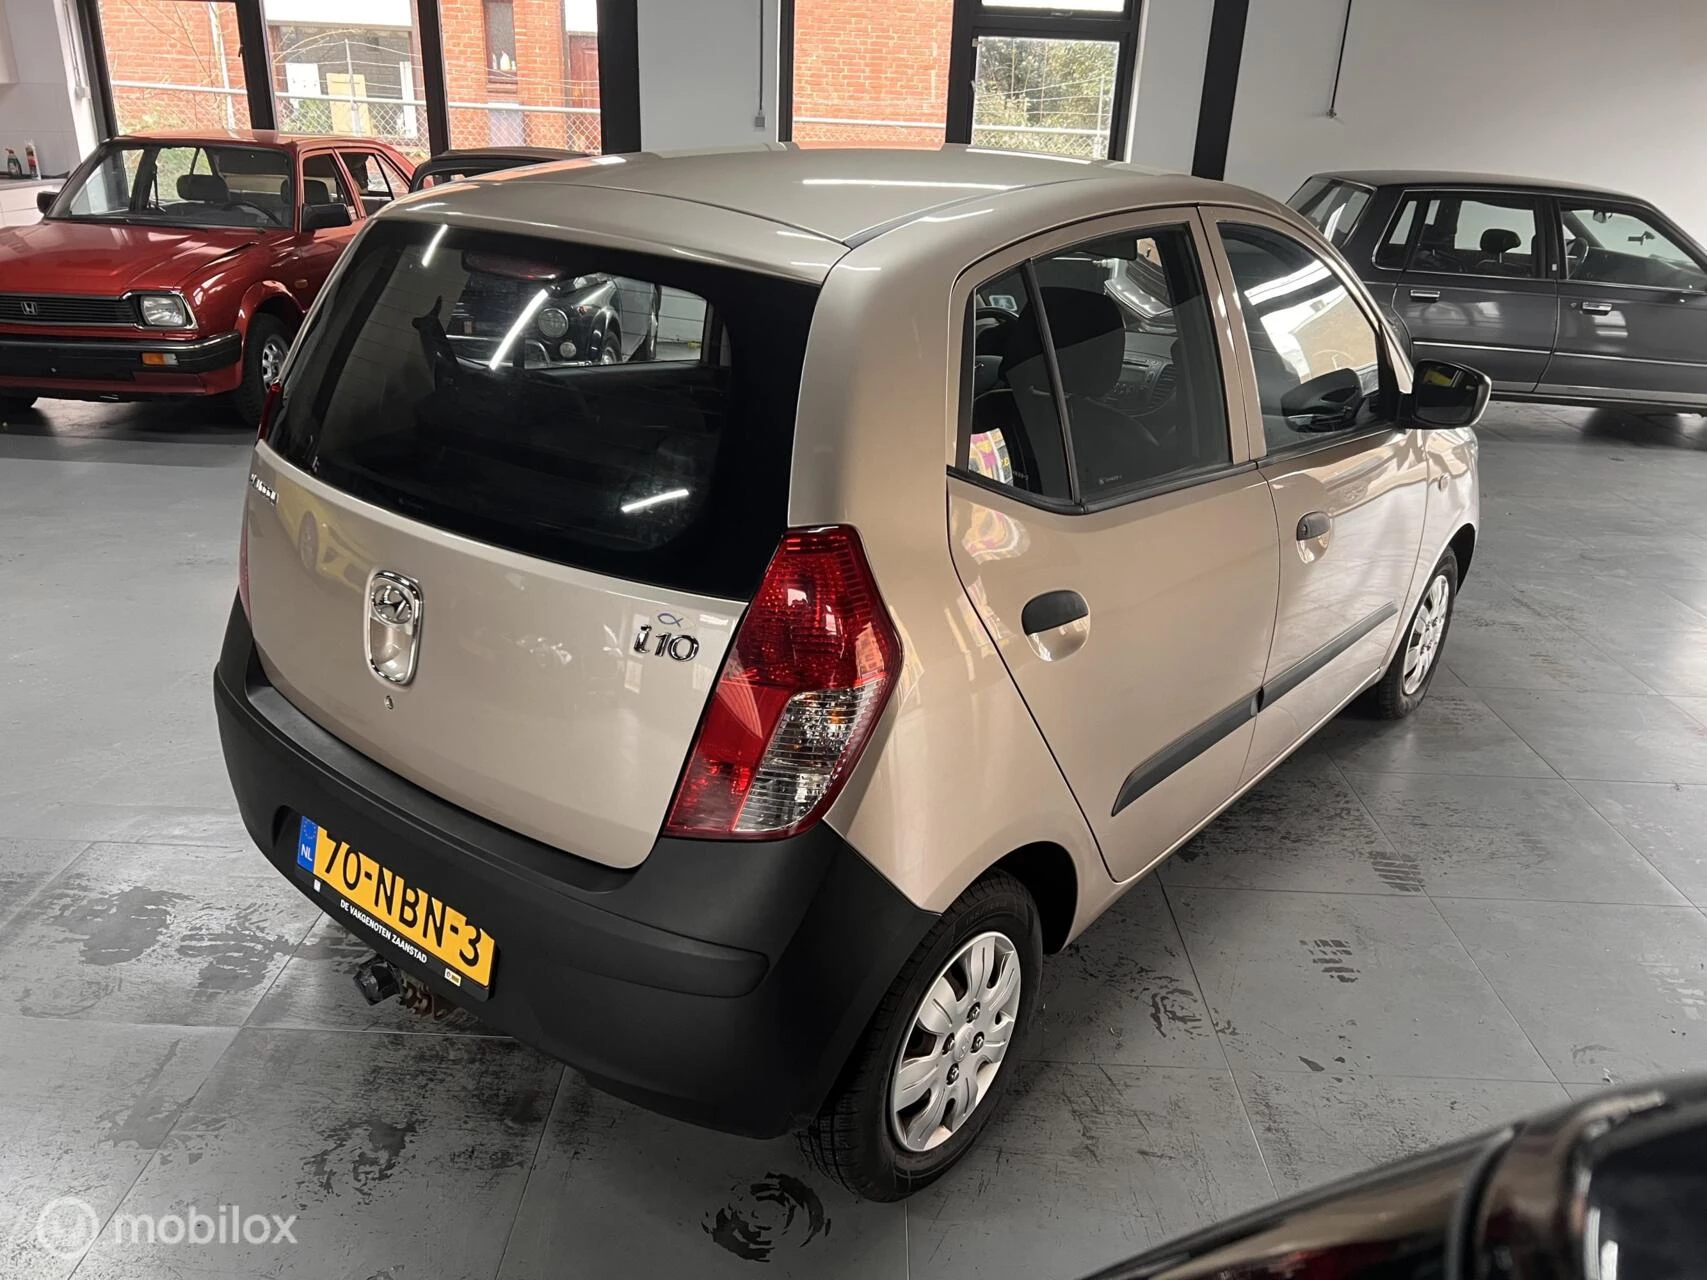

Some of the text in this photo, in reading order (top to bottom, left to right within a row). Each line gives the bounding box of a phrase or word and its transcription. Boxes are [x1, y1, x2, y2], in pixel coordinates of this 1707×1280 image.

[633, 624, 700, 662] i10
[301, 843, 313, 862] NL
[324, 828, 482, 967] 70-NBN-3
[340, 898, 427, 964] DE VAKGENOTEN ZAANSTAD
